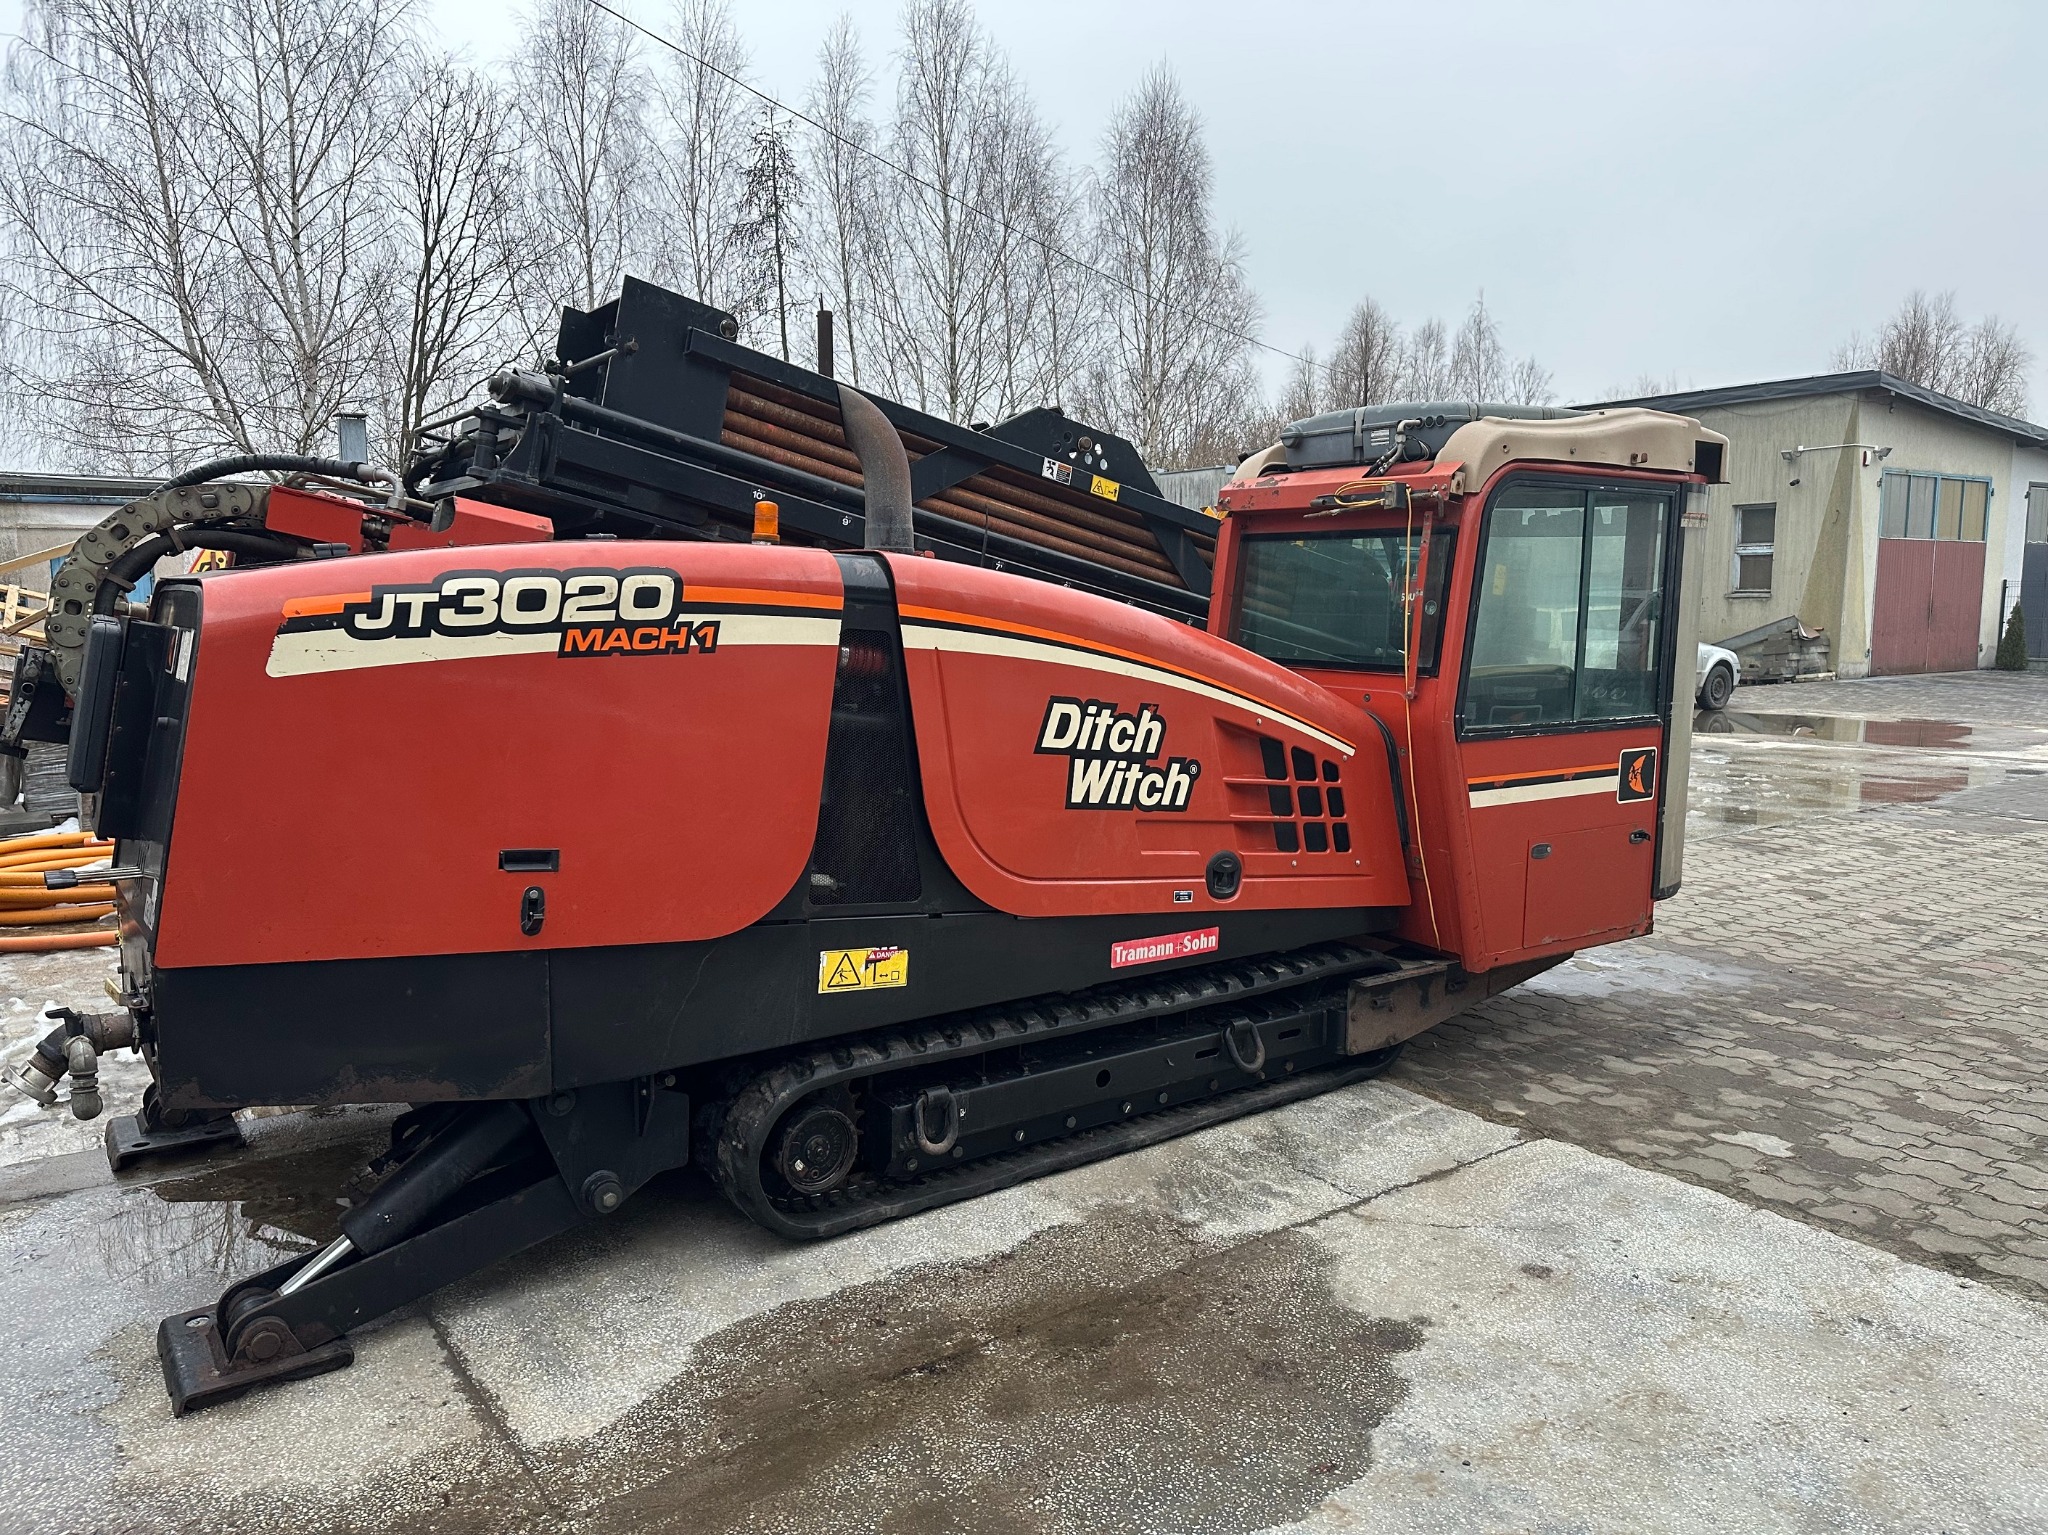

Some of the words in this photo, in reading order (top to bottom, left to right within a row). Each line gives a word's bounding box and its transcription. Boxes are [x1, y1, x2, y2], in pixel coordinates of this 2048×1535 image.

[354, 574, 675, 631] JT3020
[563, 626, 687, 653] MACH
[697, 626, 717, 649] 1
[1041, 702, 1163, 754] Ditch
